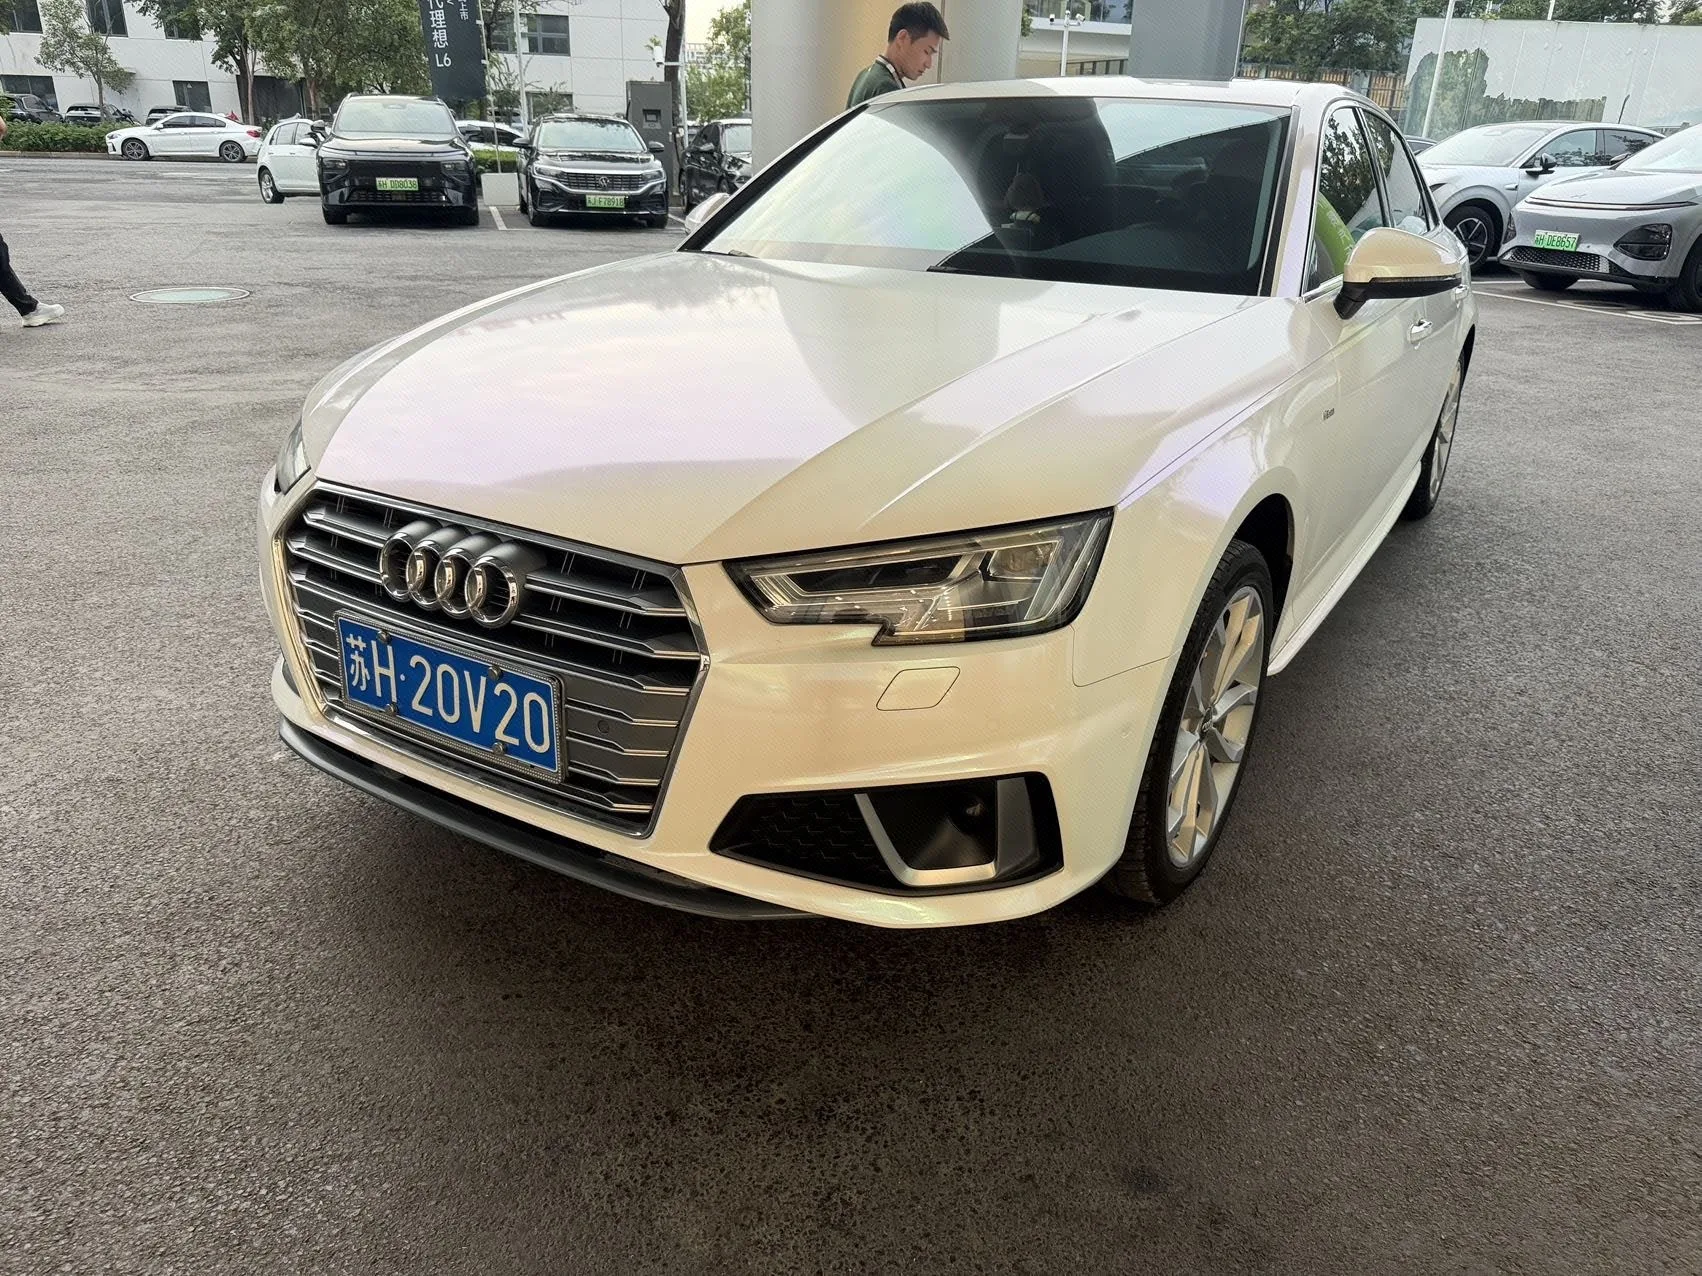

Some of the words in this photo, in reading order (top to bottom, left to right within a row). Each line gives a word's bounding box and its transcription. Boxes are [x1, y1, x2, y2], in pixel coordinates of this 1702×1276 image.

[458, 0, 469, 20] 上市
[435, 53, 452, 67] L6
[1546, 234, 1577, 249] DE8657
